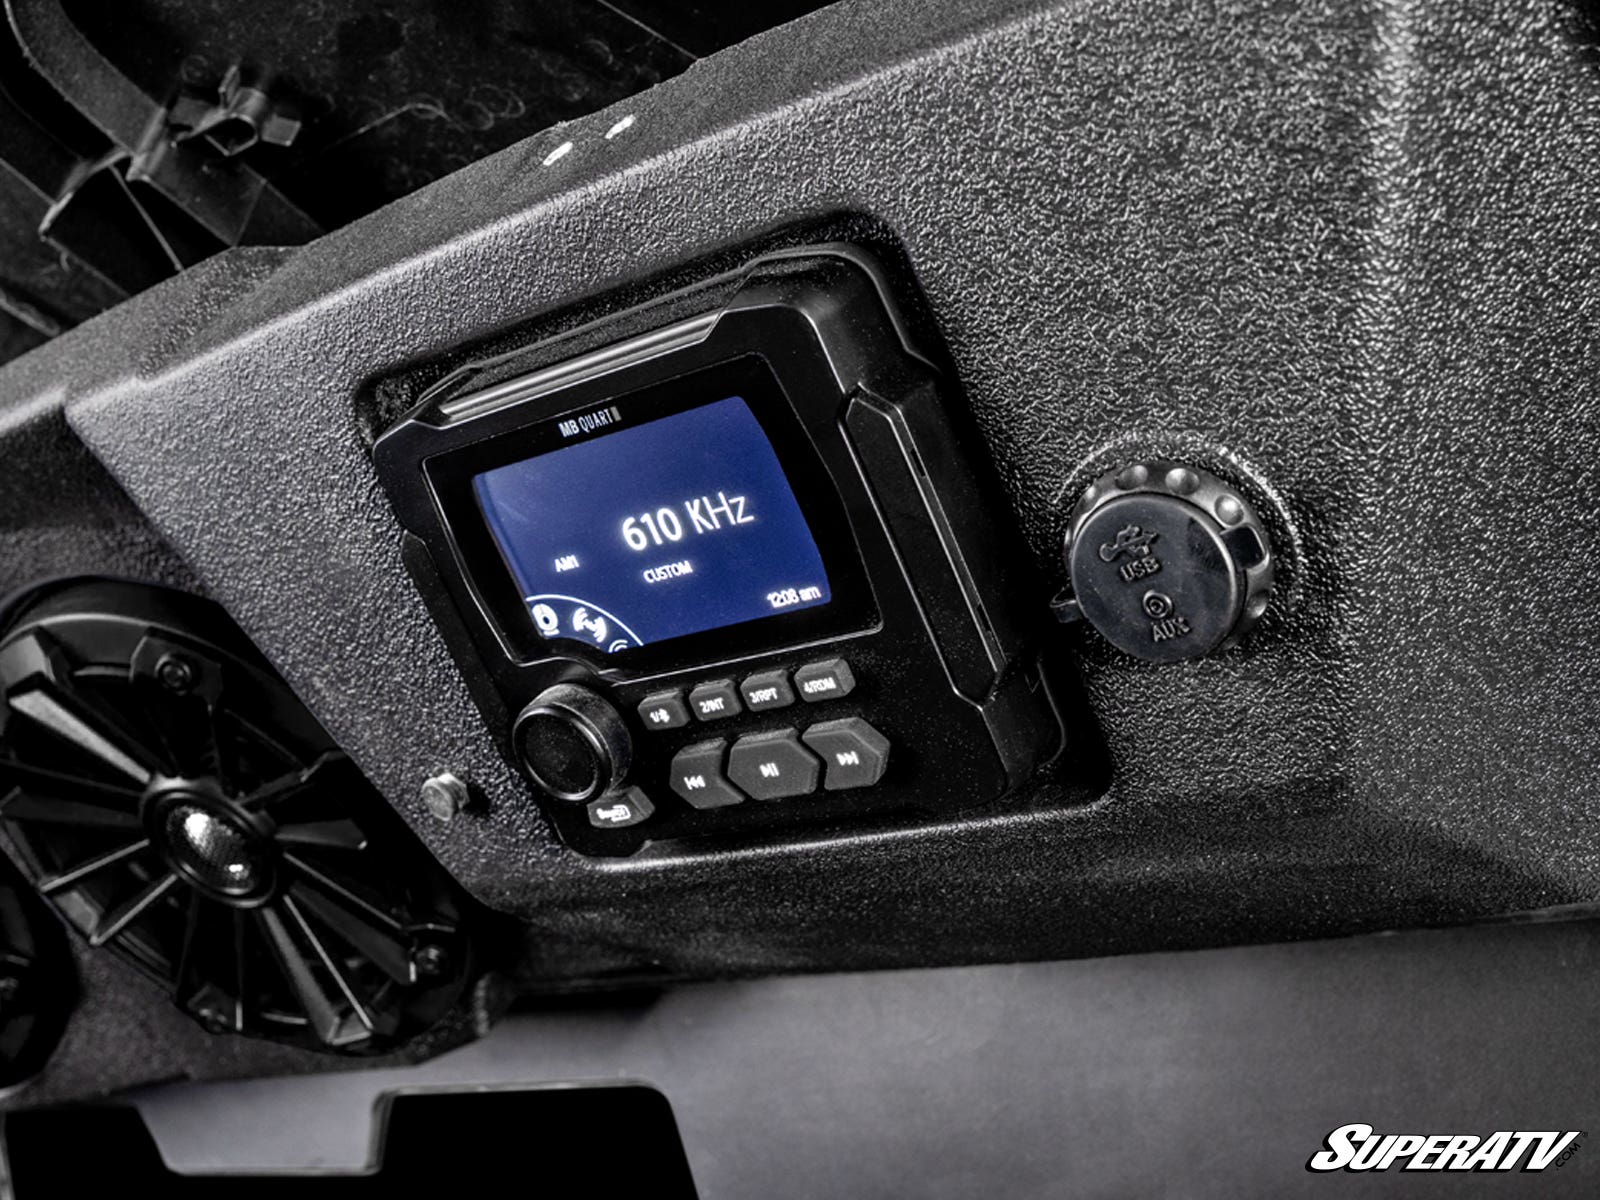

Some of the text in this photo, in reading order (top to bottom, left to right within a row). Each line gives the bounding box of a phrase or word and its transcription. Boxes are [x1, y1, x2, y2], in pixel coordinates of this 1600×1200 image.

[558, 408, 613, 438] MB QUART
[621, 491, 755, 552] 610 KHz
[554, 554, 580, 573] AM1
[642, 560, 694, 584] CUSTOM
[1119, 556, 1161, 582] USB
[798, 585, 822, 602] am
[1150, 616, 1191, 643] AUX
